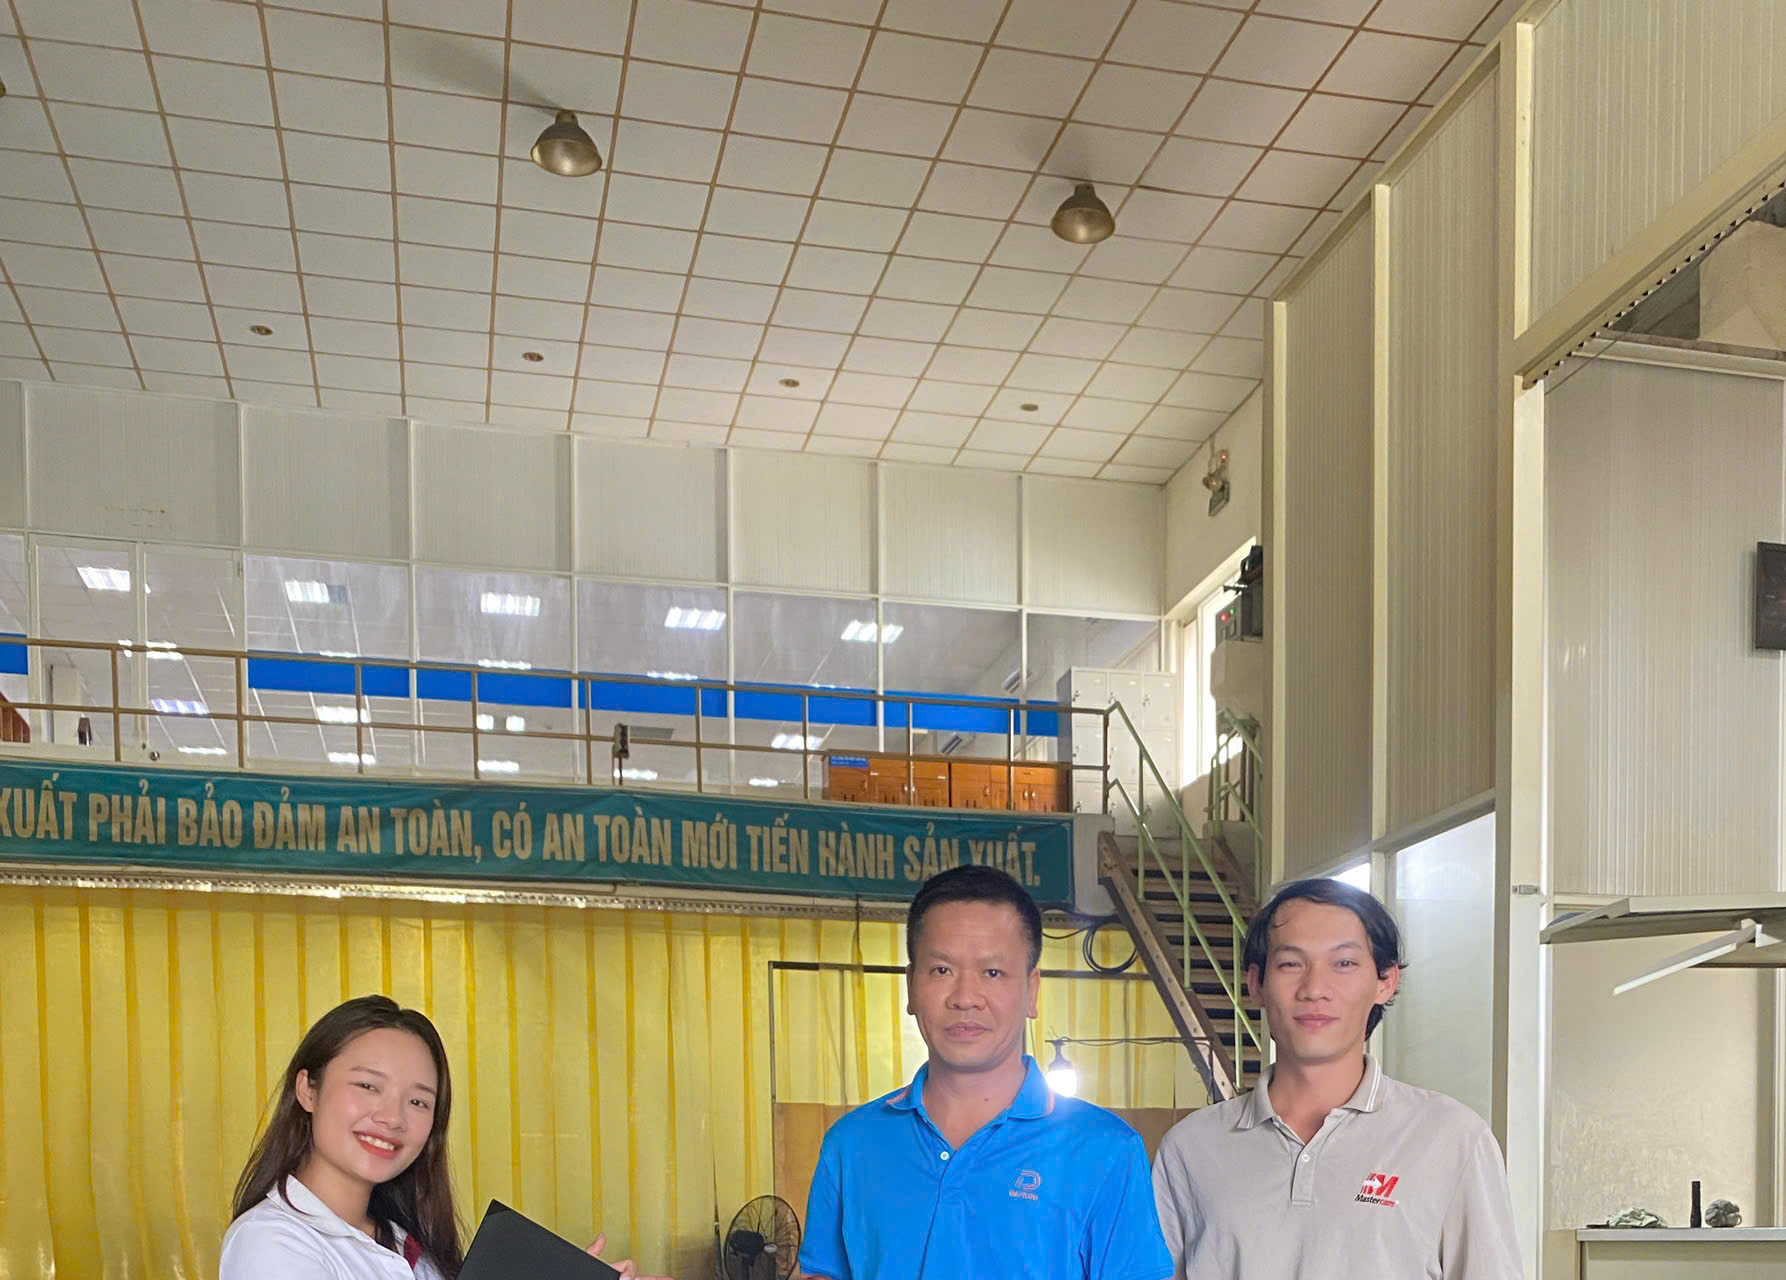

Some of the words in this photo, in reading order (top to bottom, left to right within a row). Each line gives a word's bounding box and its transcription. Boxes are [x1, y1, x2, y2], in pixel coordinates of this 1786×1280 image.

[88, 778, 166, 845] PHẢI
[177, 782, 242, 849] BẢO
[252, 786, 326, 852] ĐẢM
[336, 805, 381, 855] AN
[390, 799, 482, 863] TOÀN,
[492, 801, 533, 860] CÓ
[543, 812, 585, 862] AN
[592, 805, 673, 866] TOÀN
[681, 812, 738, 870] MỚI
[746, 813, 809, 875] TIẾN
[818, 823, 895, 880] HÀNH
[903, 822, 960, 881] SẢN
[1354, 1194, 1396, 1208] Mastercam
